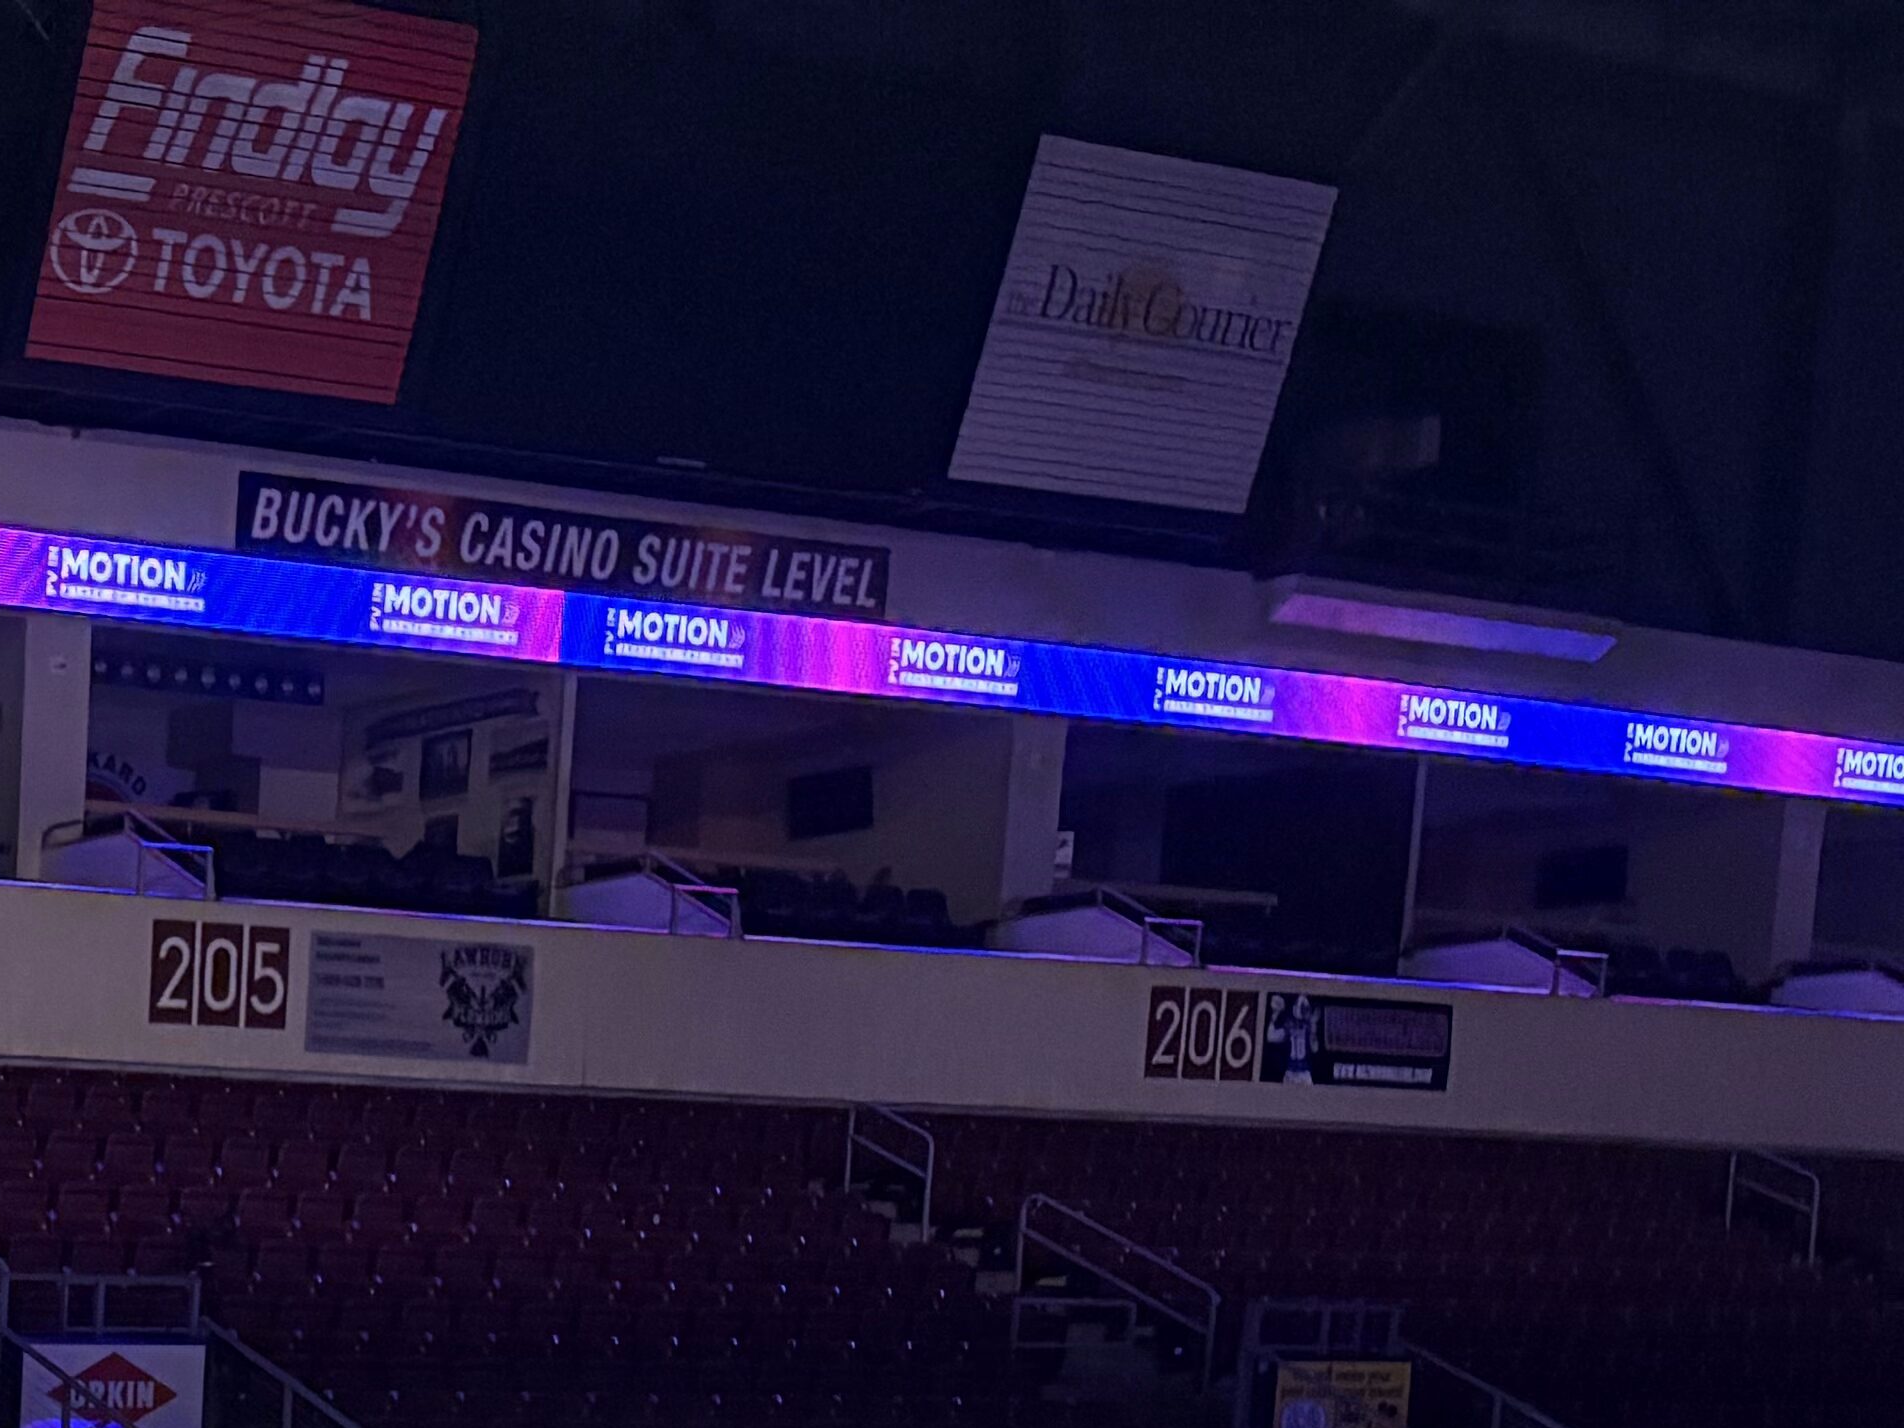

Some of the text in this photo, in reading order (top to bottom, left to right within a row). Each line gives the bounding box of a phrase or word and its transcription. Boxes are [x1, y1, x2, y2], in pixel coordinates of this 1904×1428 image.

[81, 26, 449, 238] Findlay
[151, 227, 372, 321] TOYOTA
[251, 486, 876, 608] BUCKY'S CASINO SUITE LEVEL
[60, 547, 188, 591] MOTION
[383, 583, 502, 625] MOTION
[617, 609, 729, 649] MOTION
[900, 638, 1006, 677] MOTION
[1165, 668, 1262, 705] MOTION
[1408, 694, 1498, 731] MOTION
[1633, 722, 1718, 757] MOTION
[156, 935, 285, 1015] 205
[1151, 1000, 1253, 1069] 206
